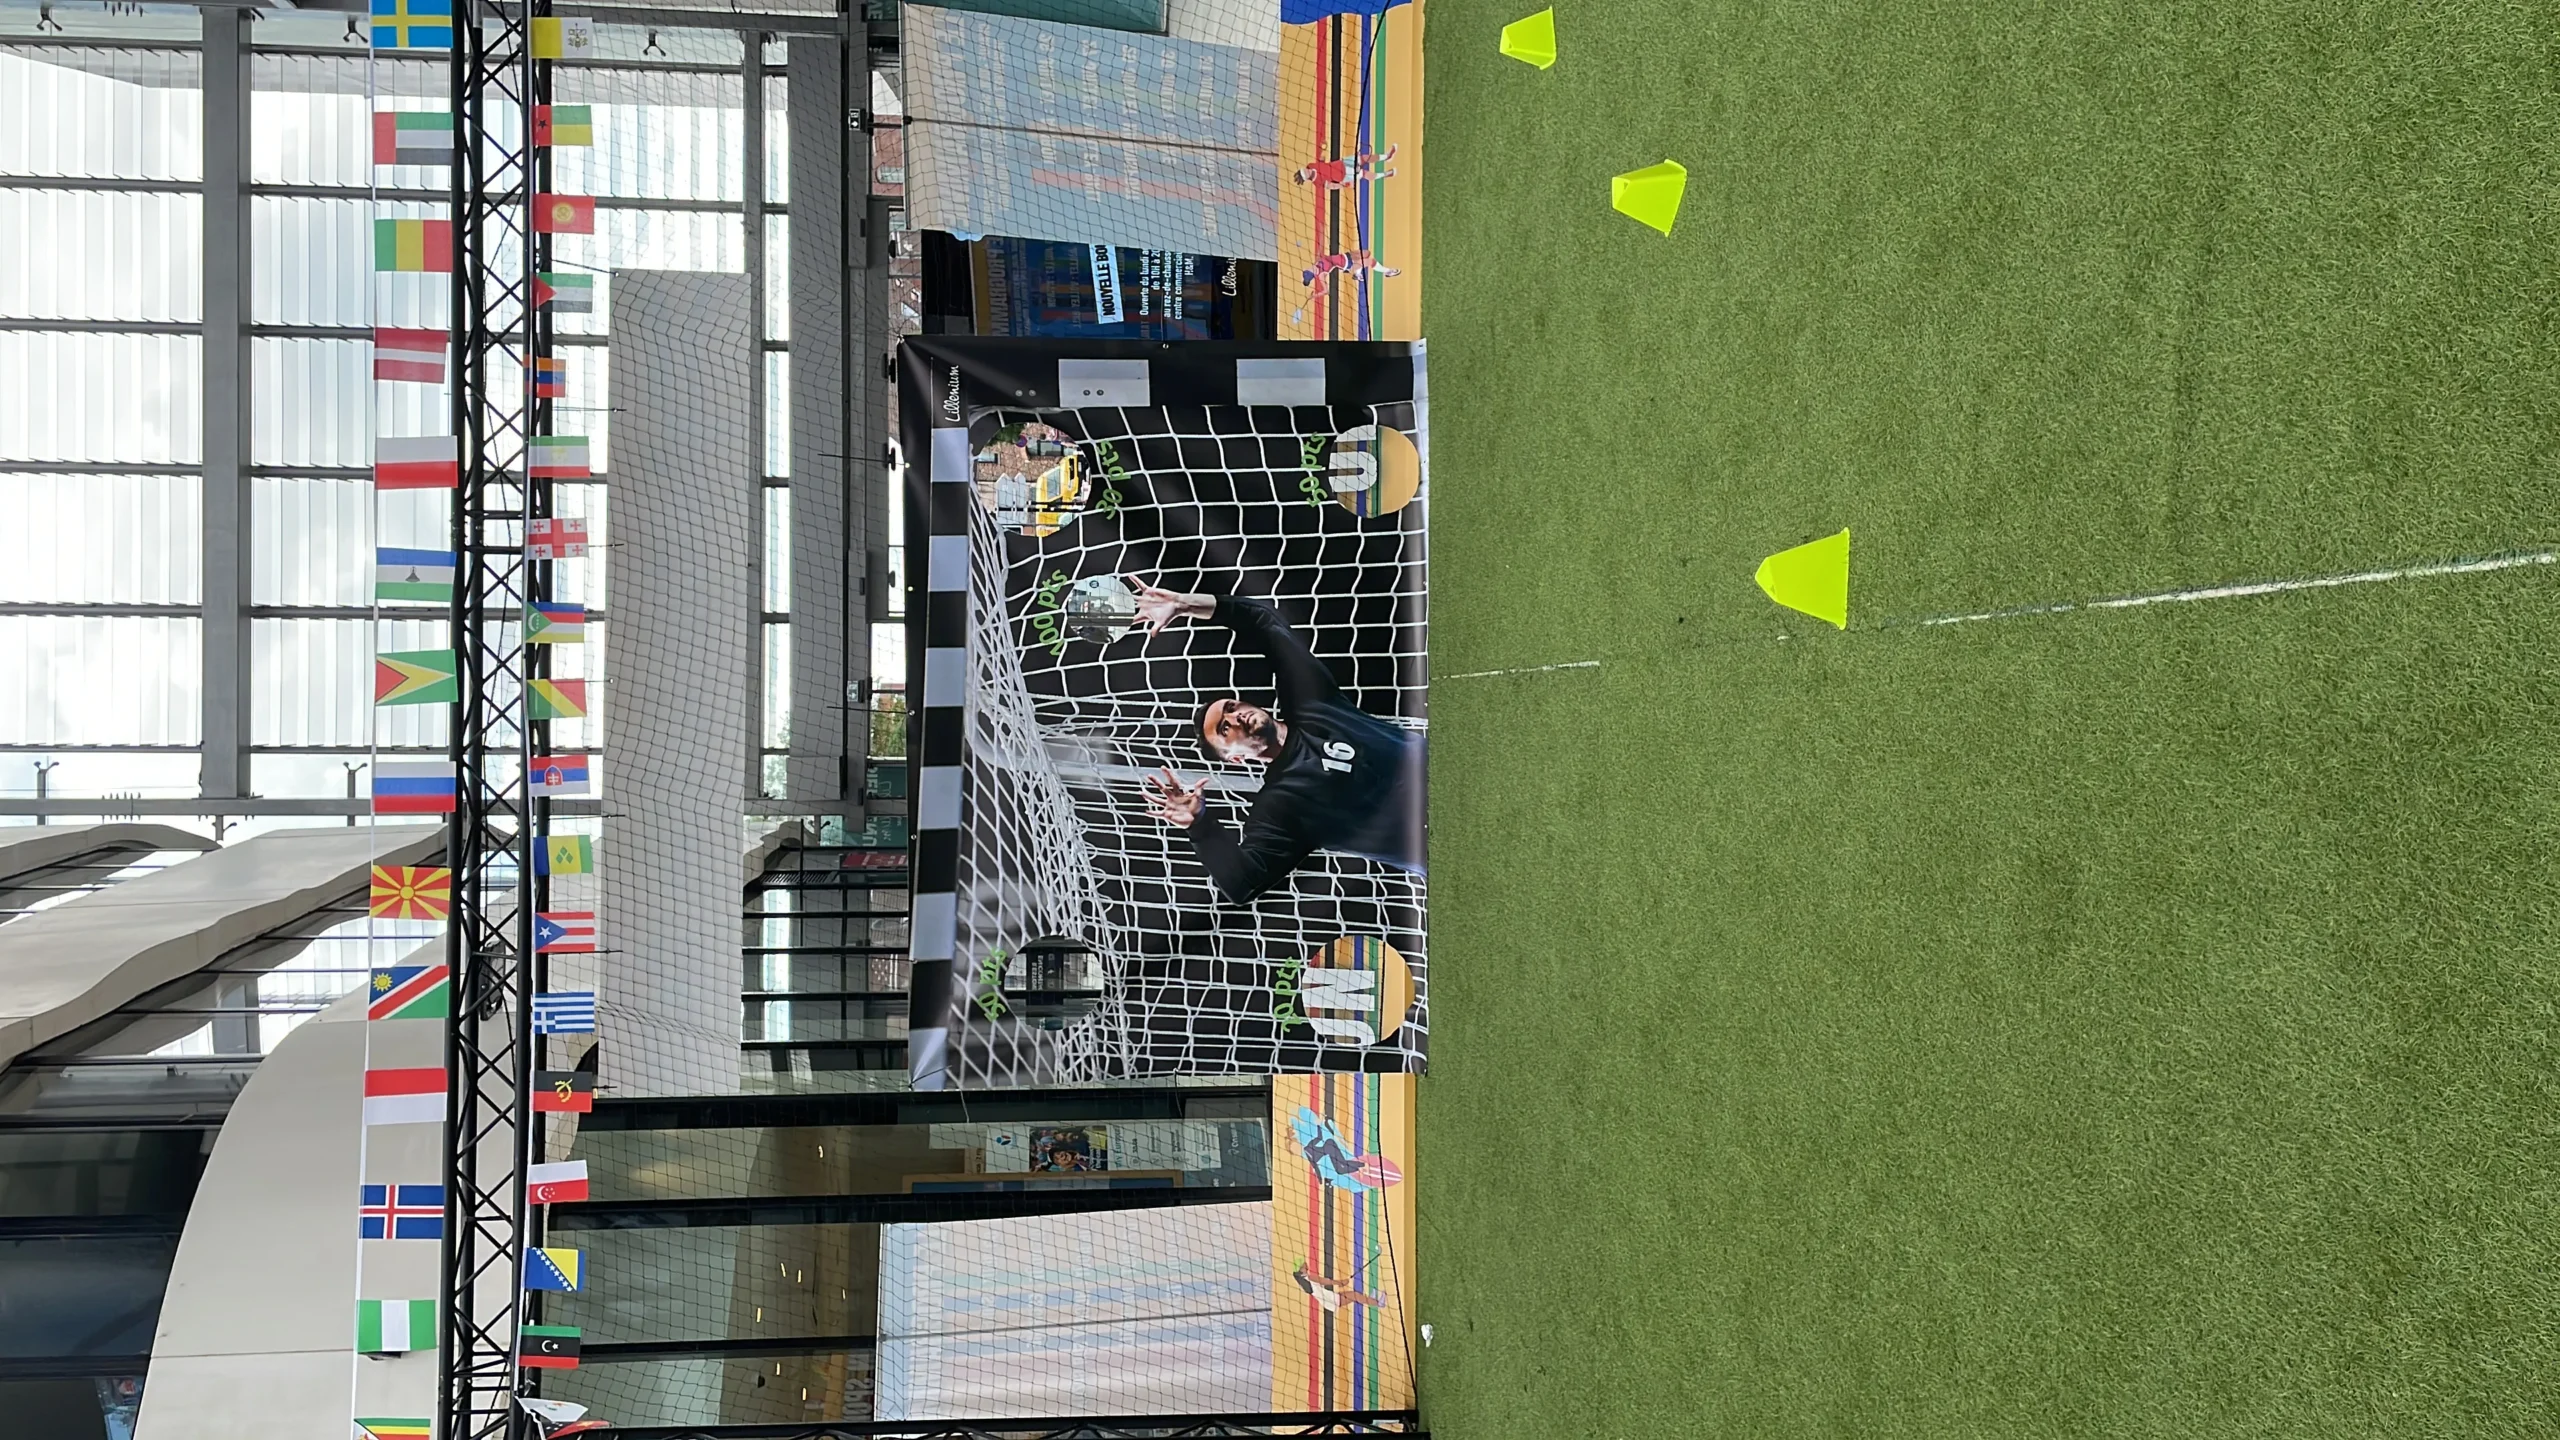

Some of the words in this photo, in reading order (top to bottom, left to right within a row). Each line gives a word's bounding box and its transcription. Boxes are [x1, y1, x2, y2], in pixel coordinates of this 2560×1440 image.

[1139, 257, 1149, 275] lundi
[1139, 277, 1149, 286] du
[1151, 266, 1160, 279] 10H
[1162, 251, 1172, 307] rez-de-chauss
[1097, 263, 1115, 316] NOUVELLE
[1151, 281, 1160, 290] de
[1139, 288, 1149, 316] Ouverte
[1163, 309, 1171, 318] au
[1174, 297, 1182, 320] centre
[943, 365, 960, 422] Lillenium
[1096, 440, 1131, 481] pts
[1300, 432, 1327, 469] pts
[1095, 489, 1123, 520] 30
[1299, 476, 1328, 507] 50
[1037, 569, 1068, 609] pts
[1033, 614, 1065, 656] 100
[1321, 742, 1355, 773] 16
[979, 946, 1008, 985] pts
[1274, 956, 1301, 996] pts
[977, 992, 1006, 1022] 50
[1274, 1003, 1303, 1032] 20
